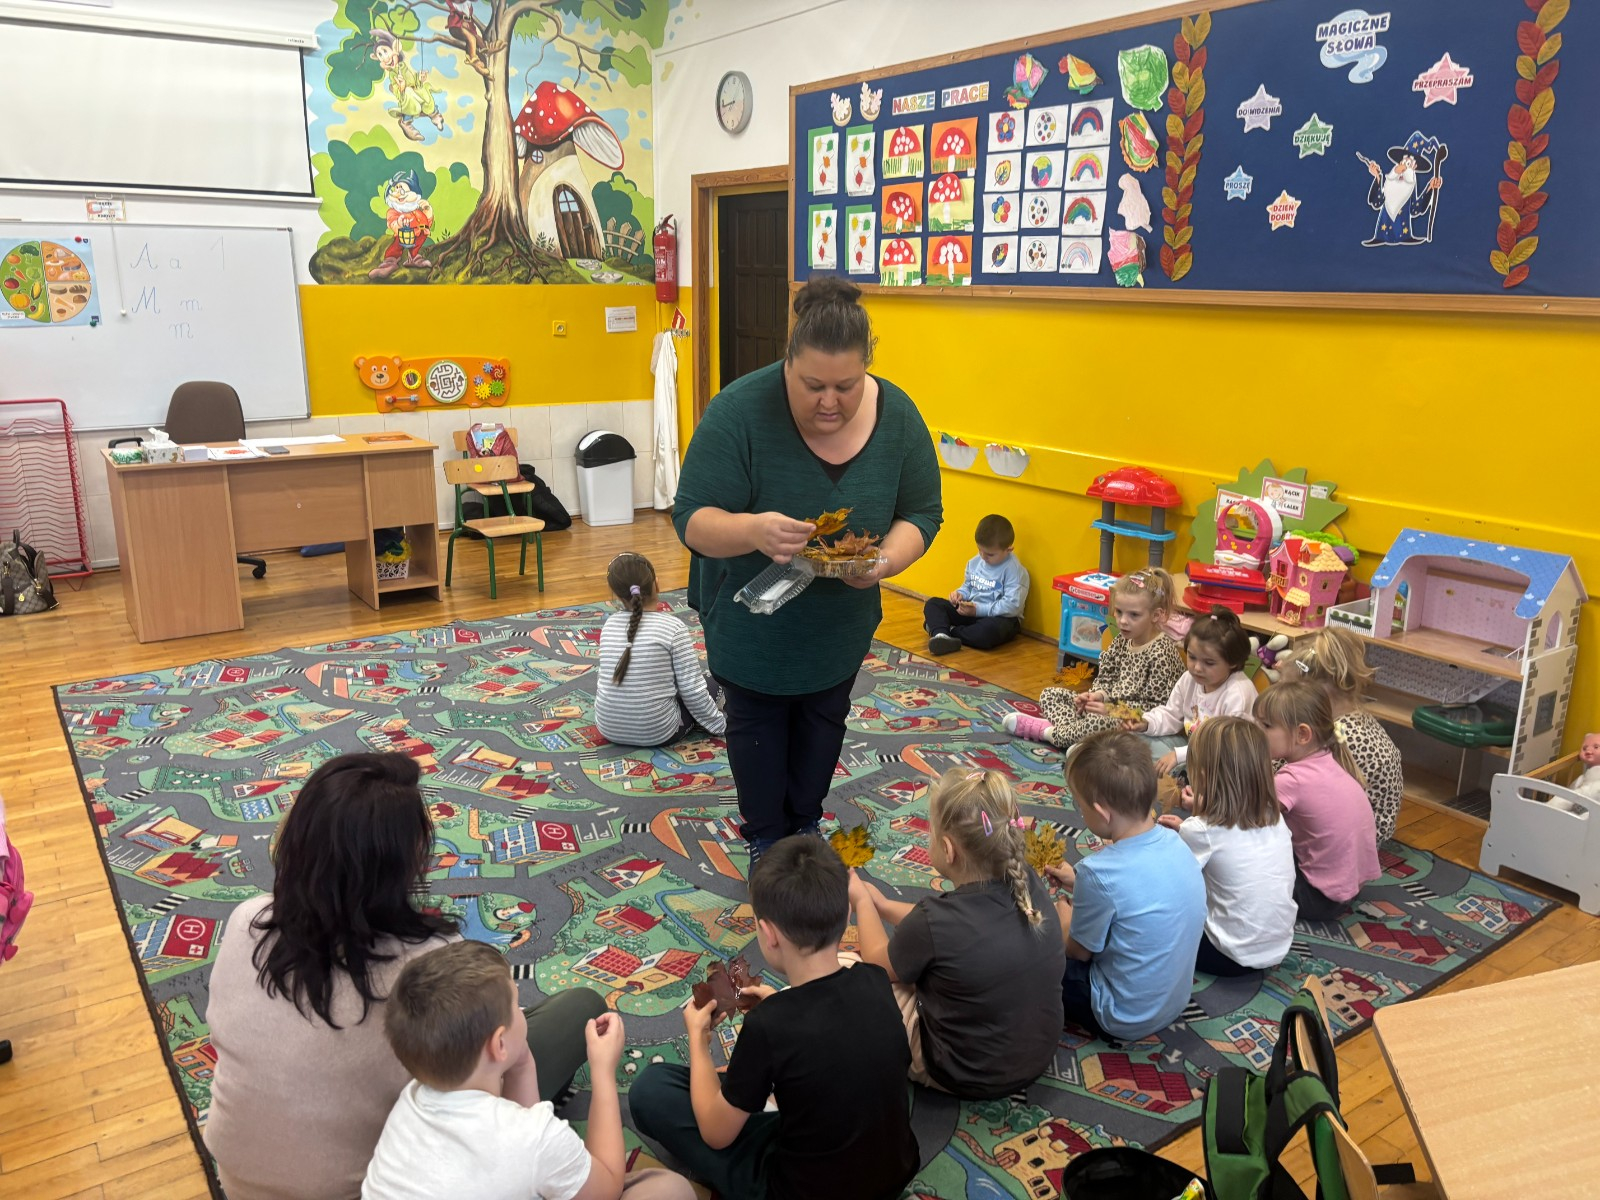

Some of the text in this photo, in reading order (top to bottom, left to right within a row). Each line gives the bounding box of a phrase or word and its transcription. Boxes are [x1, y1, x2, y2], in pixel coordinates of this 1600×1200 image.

[1318, 16, 1388, 39] MAGICZNE
[1327, 36, 1374, 54] SŁOWA
[1414, 77, 1472, 89] PRZEPRASZAM
[893, 84, 989, 114] NASZE PRACE
[1238, 108, 1247, 116] DO
[1294, 134, 1330, 144] DZIĘKUJĘ
[1271, 213, 1295, 221] DOBRY
[132, 286, 161, 314] M
